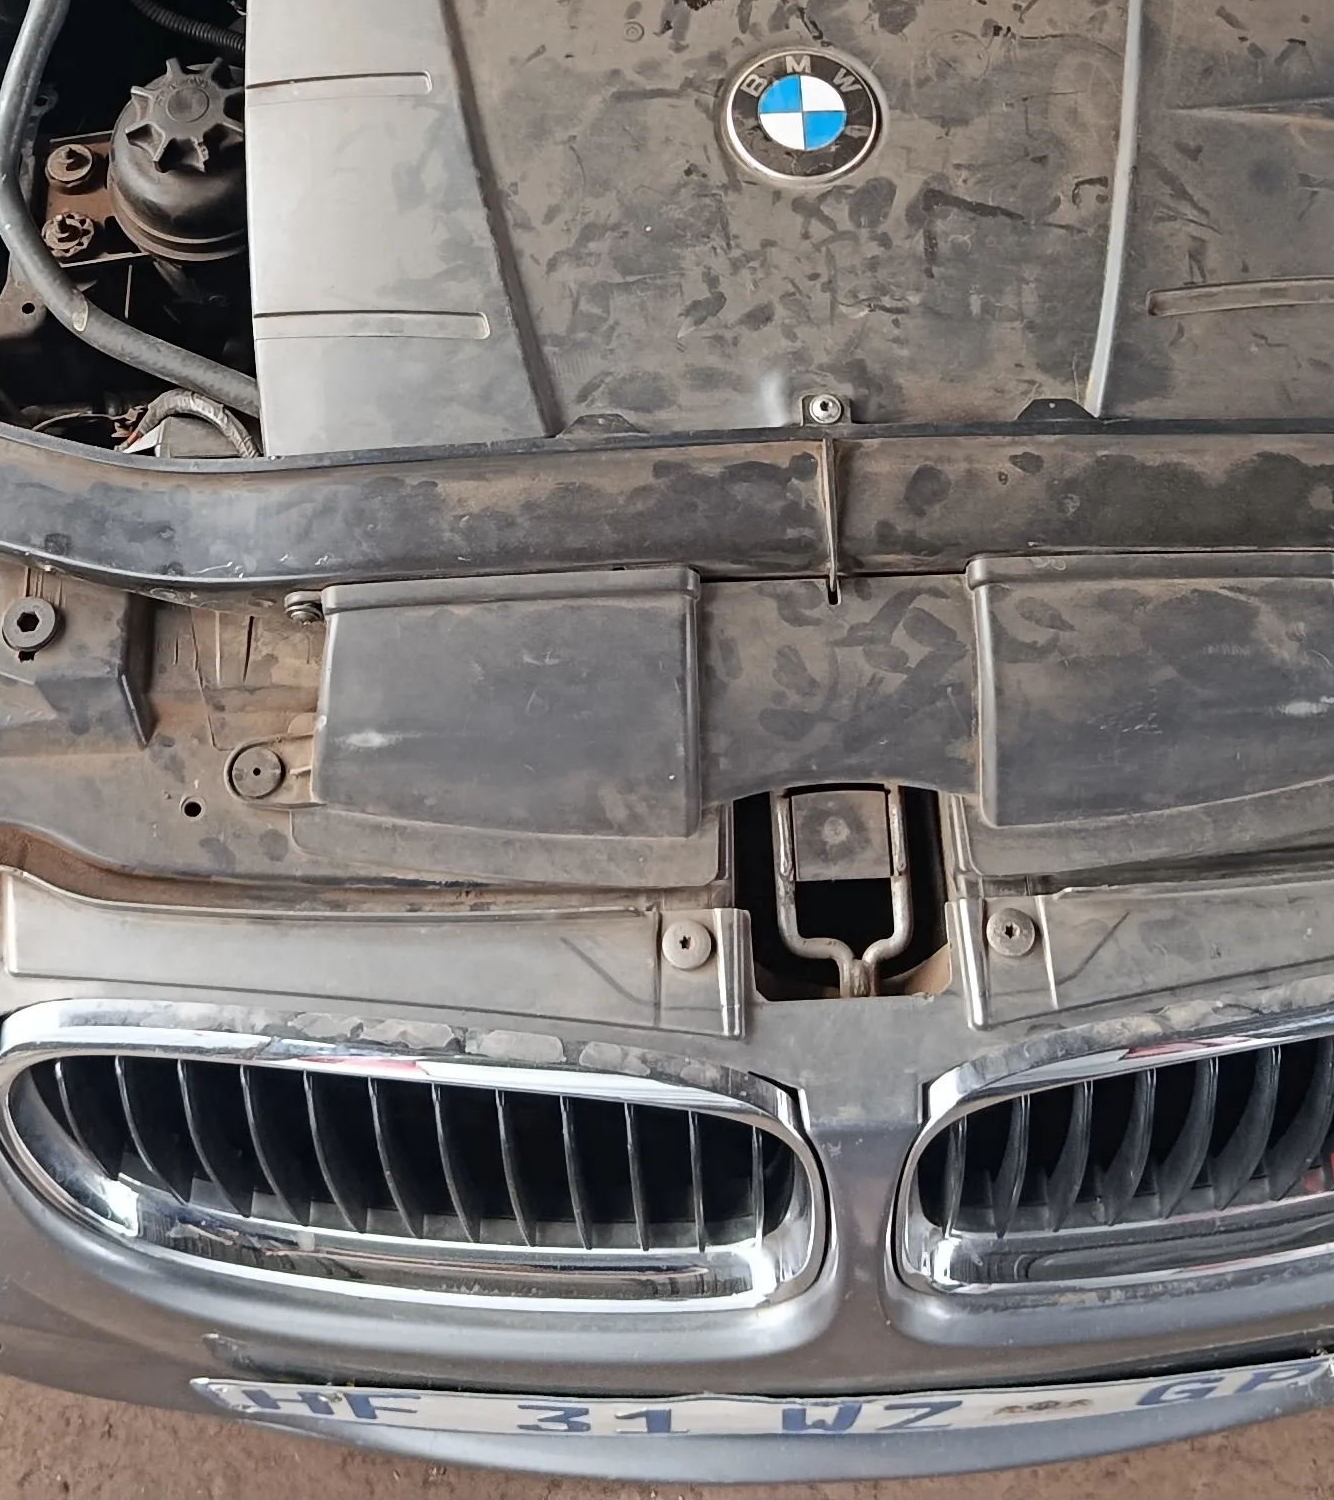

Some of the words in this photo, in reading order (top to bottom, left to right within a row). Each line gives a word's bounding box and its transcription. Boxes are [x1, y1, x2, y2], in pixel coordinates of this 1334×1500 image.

[740, 55, 862, 97] BMW
[241, 1389, 422, 1420] HF
[517, 1404, 689, 1434] 31
[781, 1400, 963, 1433] WZ
